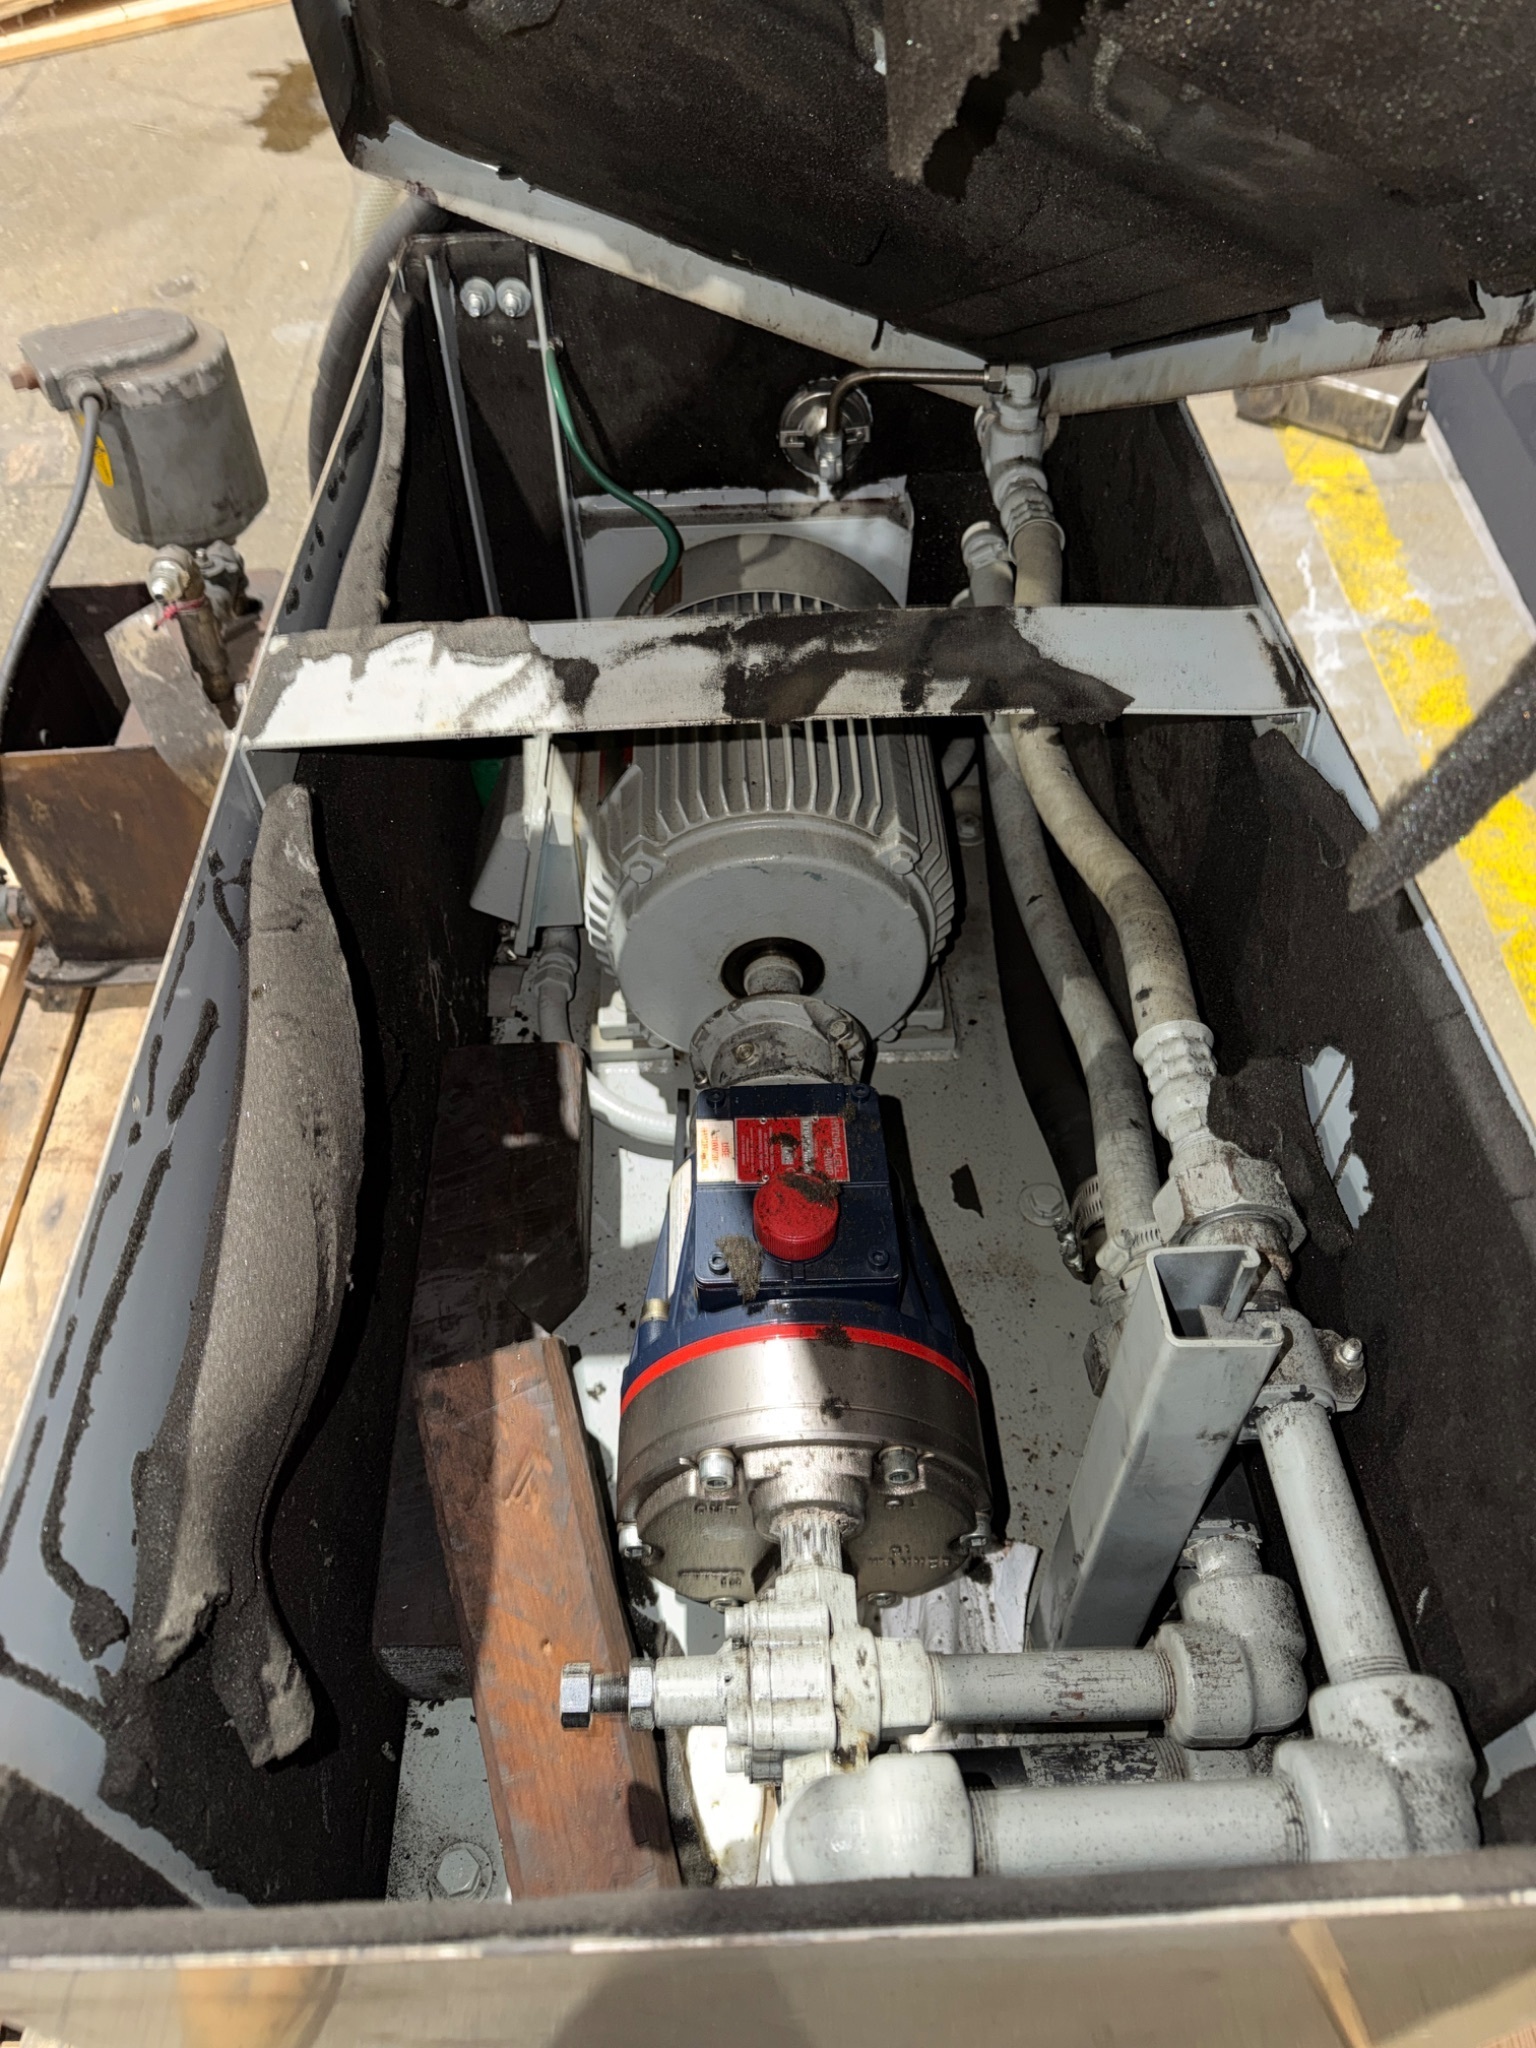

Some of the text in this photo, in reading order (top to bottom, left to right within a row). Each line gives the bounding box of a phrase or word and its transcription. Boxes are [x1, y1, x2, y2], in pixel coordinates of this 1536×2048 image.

[721, 1141, 731, 1158] USE
[831, 1119, 844, 1174] HYDRA-CELL
[823, 1147, 834, 1175] PUMP
